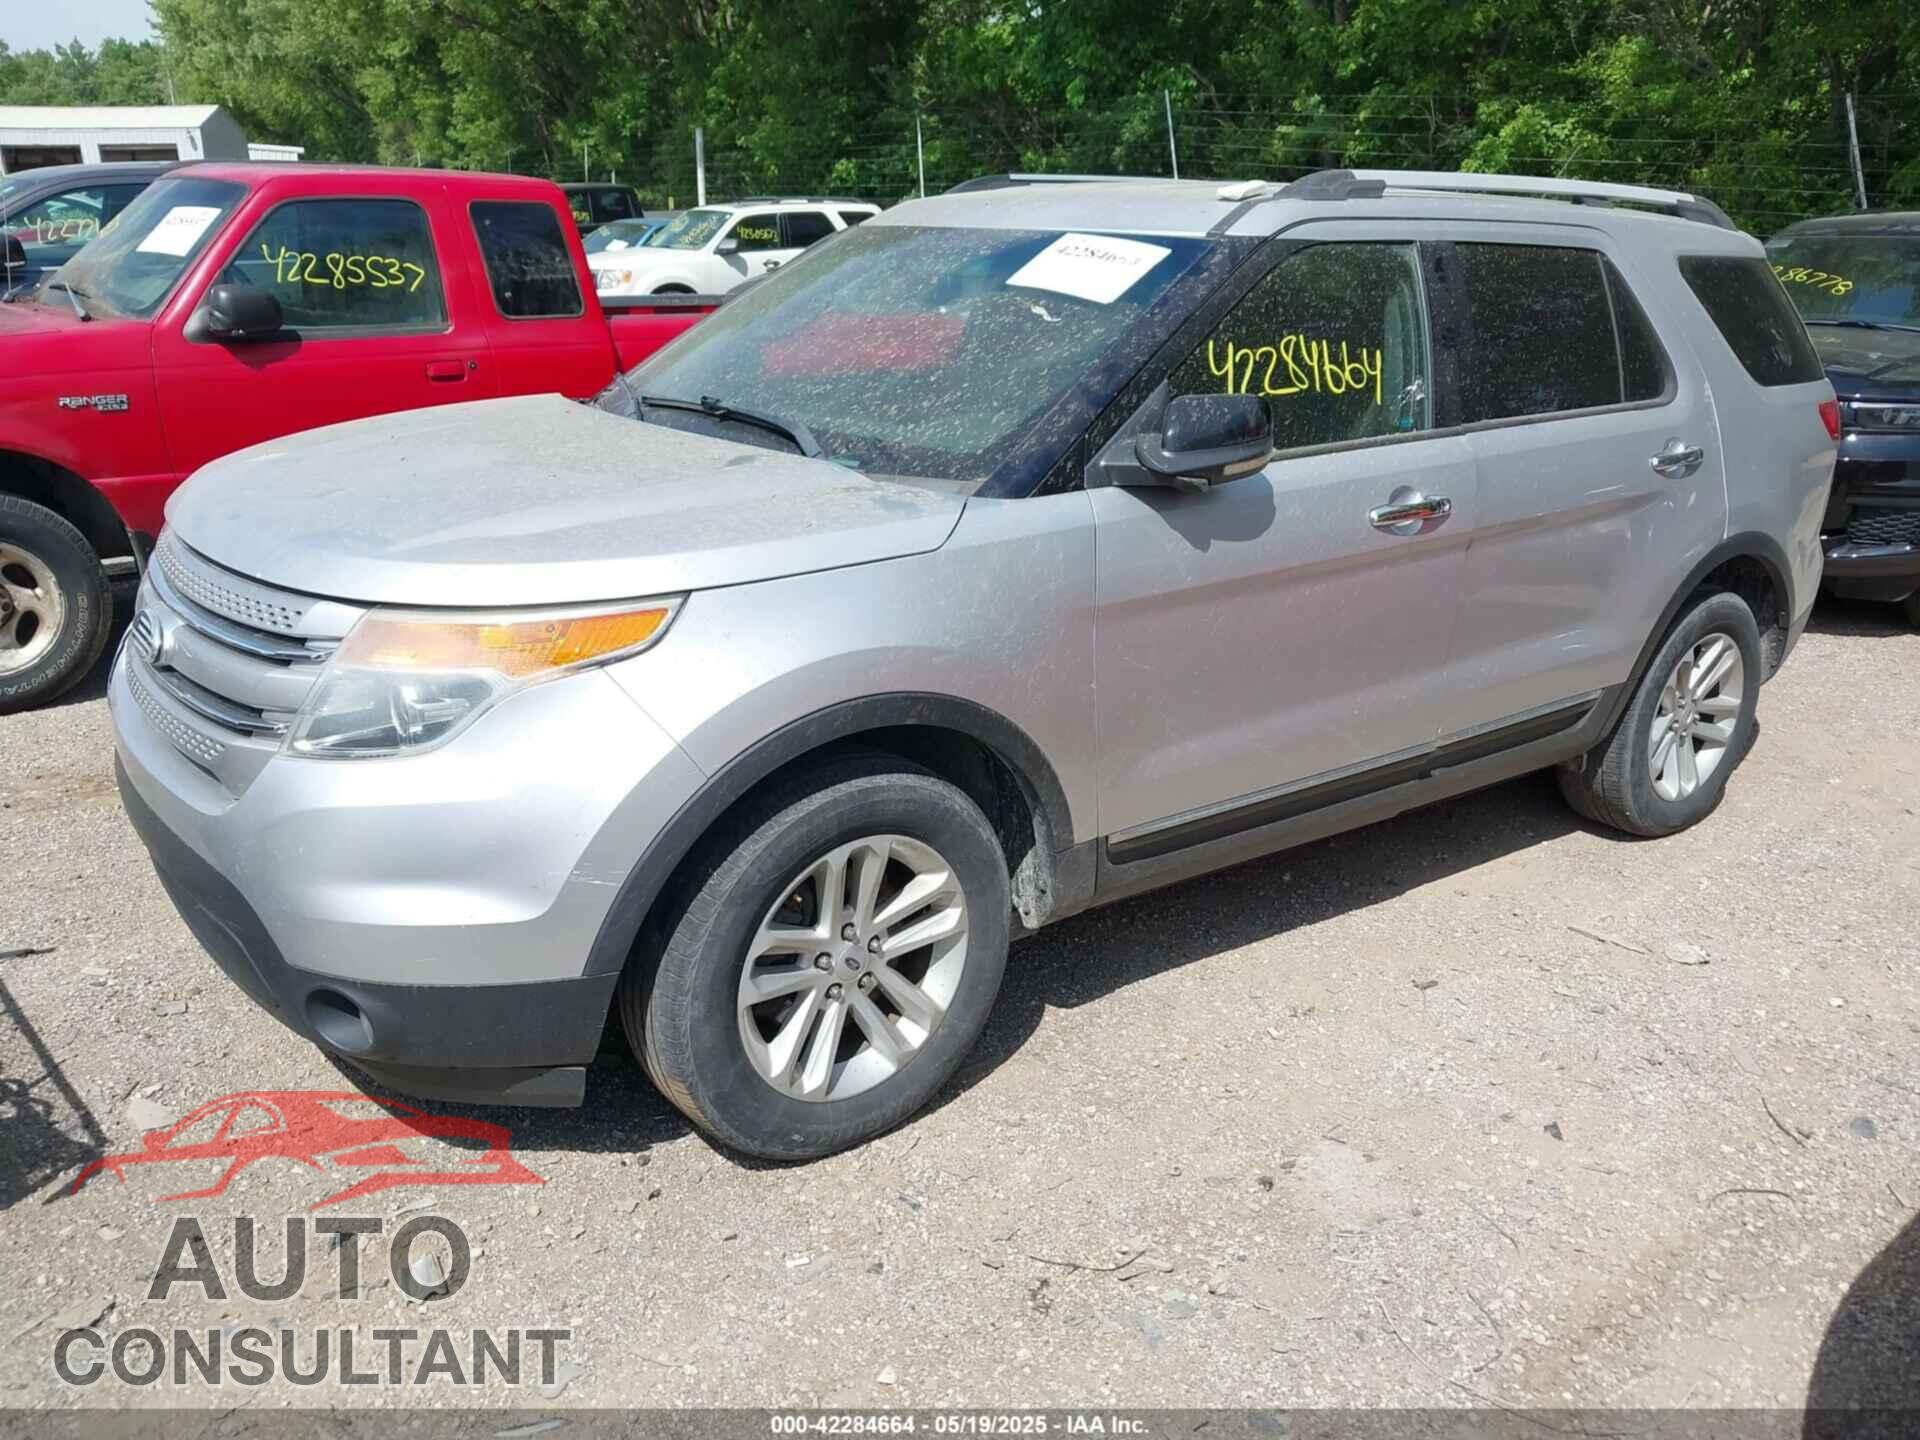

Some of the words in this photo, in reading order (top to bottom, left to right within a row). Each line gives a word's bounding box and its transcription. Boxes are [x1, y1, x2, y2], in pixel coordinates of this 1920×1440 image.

[260, 243, 425, 293] 42285537
[1208, 333, 1382, 406] 42284664
[59, 394, 128, 408] RANGER
